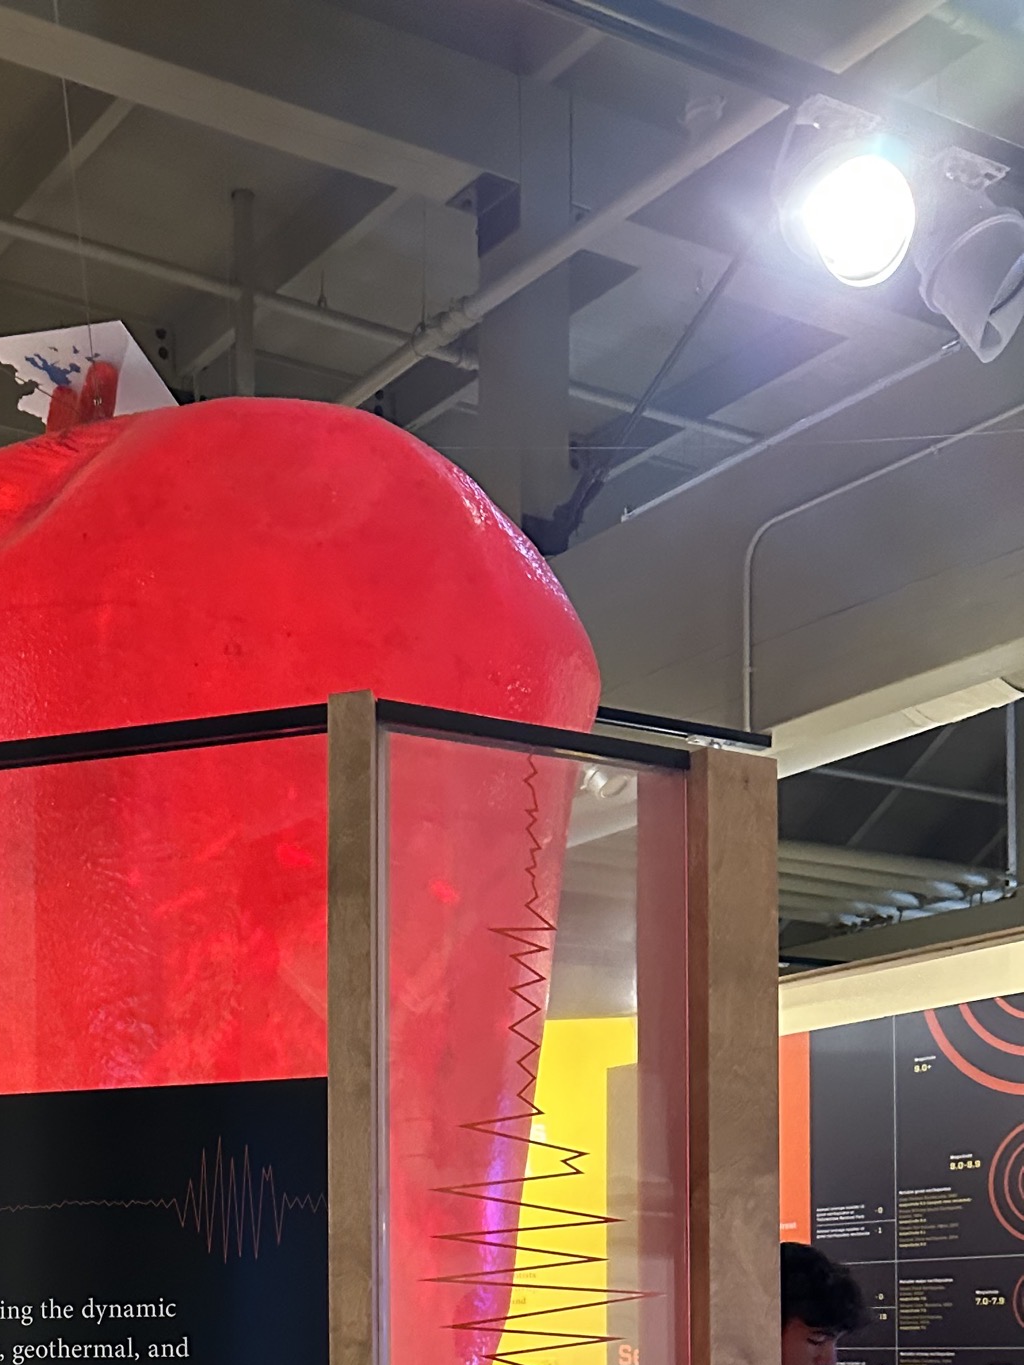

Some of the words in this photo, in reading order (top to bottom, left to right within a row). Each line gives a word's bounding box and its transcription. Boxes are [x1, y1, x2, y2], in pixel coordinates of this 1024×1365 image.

[41, 1299, 73, 1318] the
[82, 1298, 176, 1324] dynamic
[13, 1337, 139, 1365] geothermal,
[149, 1337, 189, 1357] and
